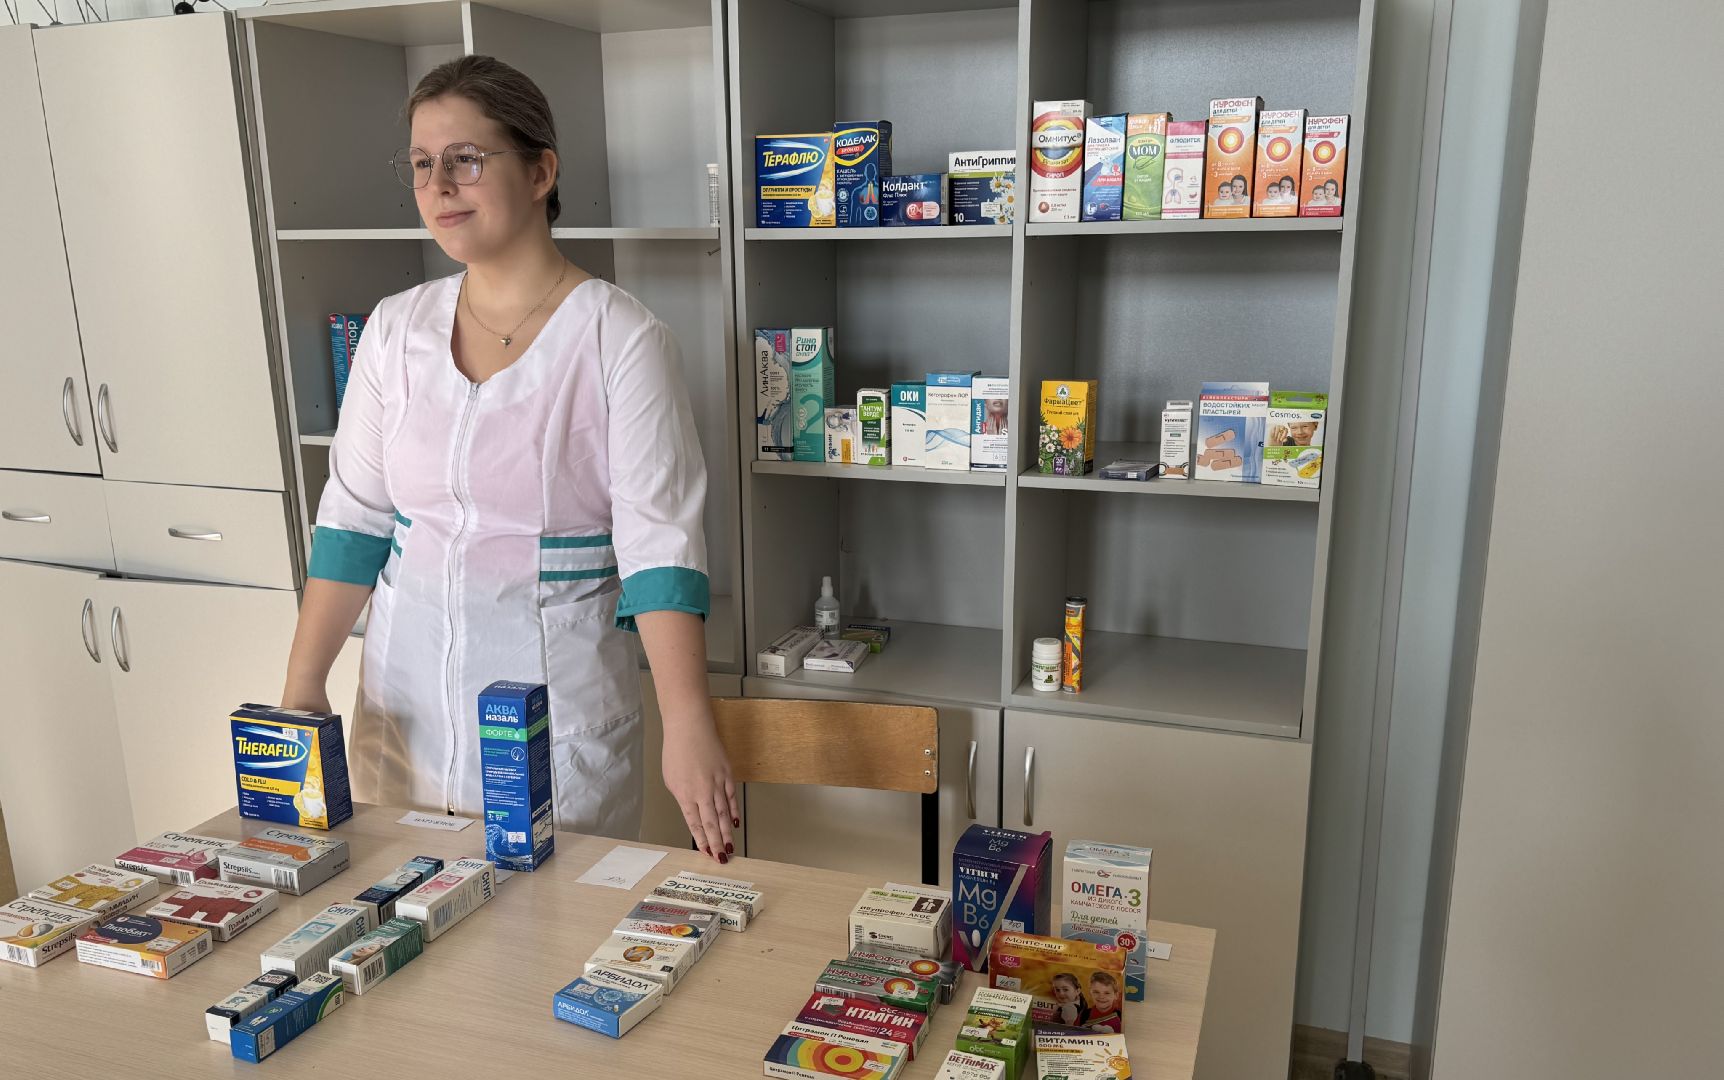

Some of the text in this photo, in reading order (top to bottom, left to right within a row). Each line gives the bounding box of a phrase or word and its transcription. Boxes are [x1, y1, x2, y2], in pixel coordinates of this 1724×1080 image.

[1213, 100, 1253, 109] НУРОФЕН
[1261, 111, 1300, 119] НУРОФЕН
[836, 134, 876, 148] КОДЕЛАК
[1133, 146, 1157, 156] МОМ
[763, 151, 819, 167] ТЕРАФЛЮ
[882, 181, 926, 193] Колдакт
[954, 212, 965, 223] 10
[796, 336, 817, 345] Рино
[900, 390, 919, 402] ОКИ
[1202, 401, 1251, 409] ВОДОСТОЙКИХ
[485, 703, 518, 716] АКВА
[485, 714, 519, 723] назаль
[485, 729, 513, 738] ФОРТЕ
[235, 736, 299, 758] THERAFLU
[223, 861, 253, 874] Strepsils
[456, 860, 485, 870] СНУП
[959, 866, 999, 880] VITRUM
[481, 871, 492, 900] СНУП
[664, 879, 756, 902] Эргоферон
[957, 879, 997, 911] Mg
[1097, 897, 1123, 906] ДИКОГО
[327, 906, 360, 916] СНУП
[640, 904, 688, 916] ИБУКЛИН
[1070, 899, 1142, 914] КАМЧАТСКОГО ЛОСОСЯ
[963, 902, 990, 930] B6
[1070, 910, 1119, 926] Для детей
[355, 916, 366, 938] СНУ
[42, 932, 77, 954] Strepsils
[853, 950, 910, 966] НУРОФЕН
[592, 969, 649, 991] АРБИДОЛ
[826, 968, 885, 984] НУРОФЕН
[557, 1001, 590, 1017] АРБИДОЛ
[811, 1000, 916, 1028] ПНТАЛГИН
[791, 1025, 830, 1037] Цитрамон
[878, 1028, 893, 1037] 24
[1038, 1037, 1094, 1046] ВИТАМИН
[948, 1055, 997, 1071] DETRIMAX
